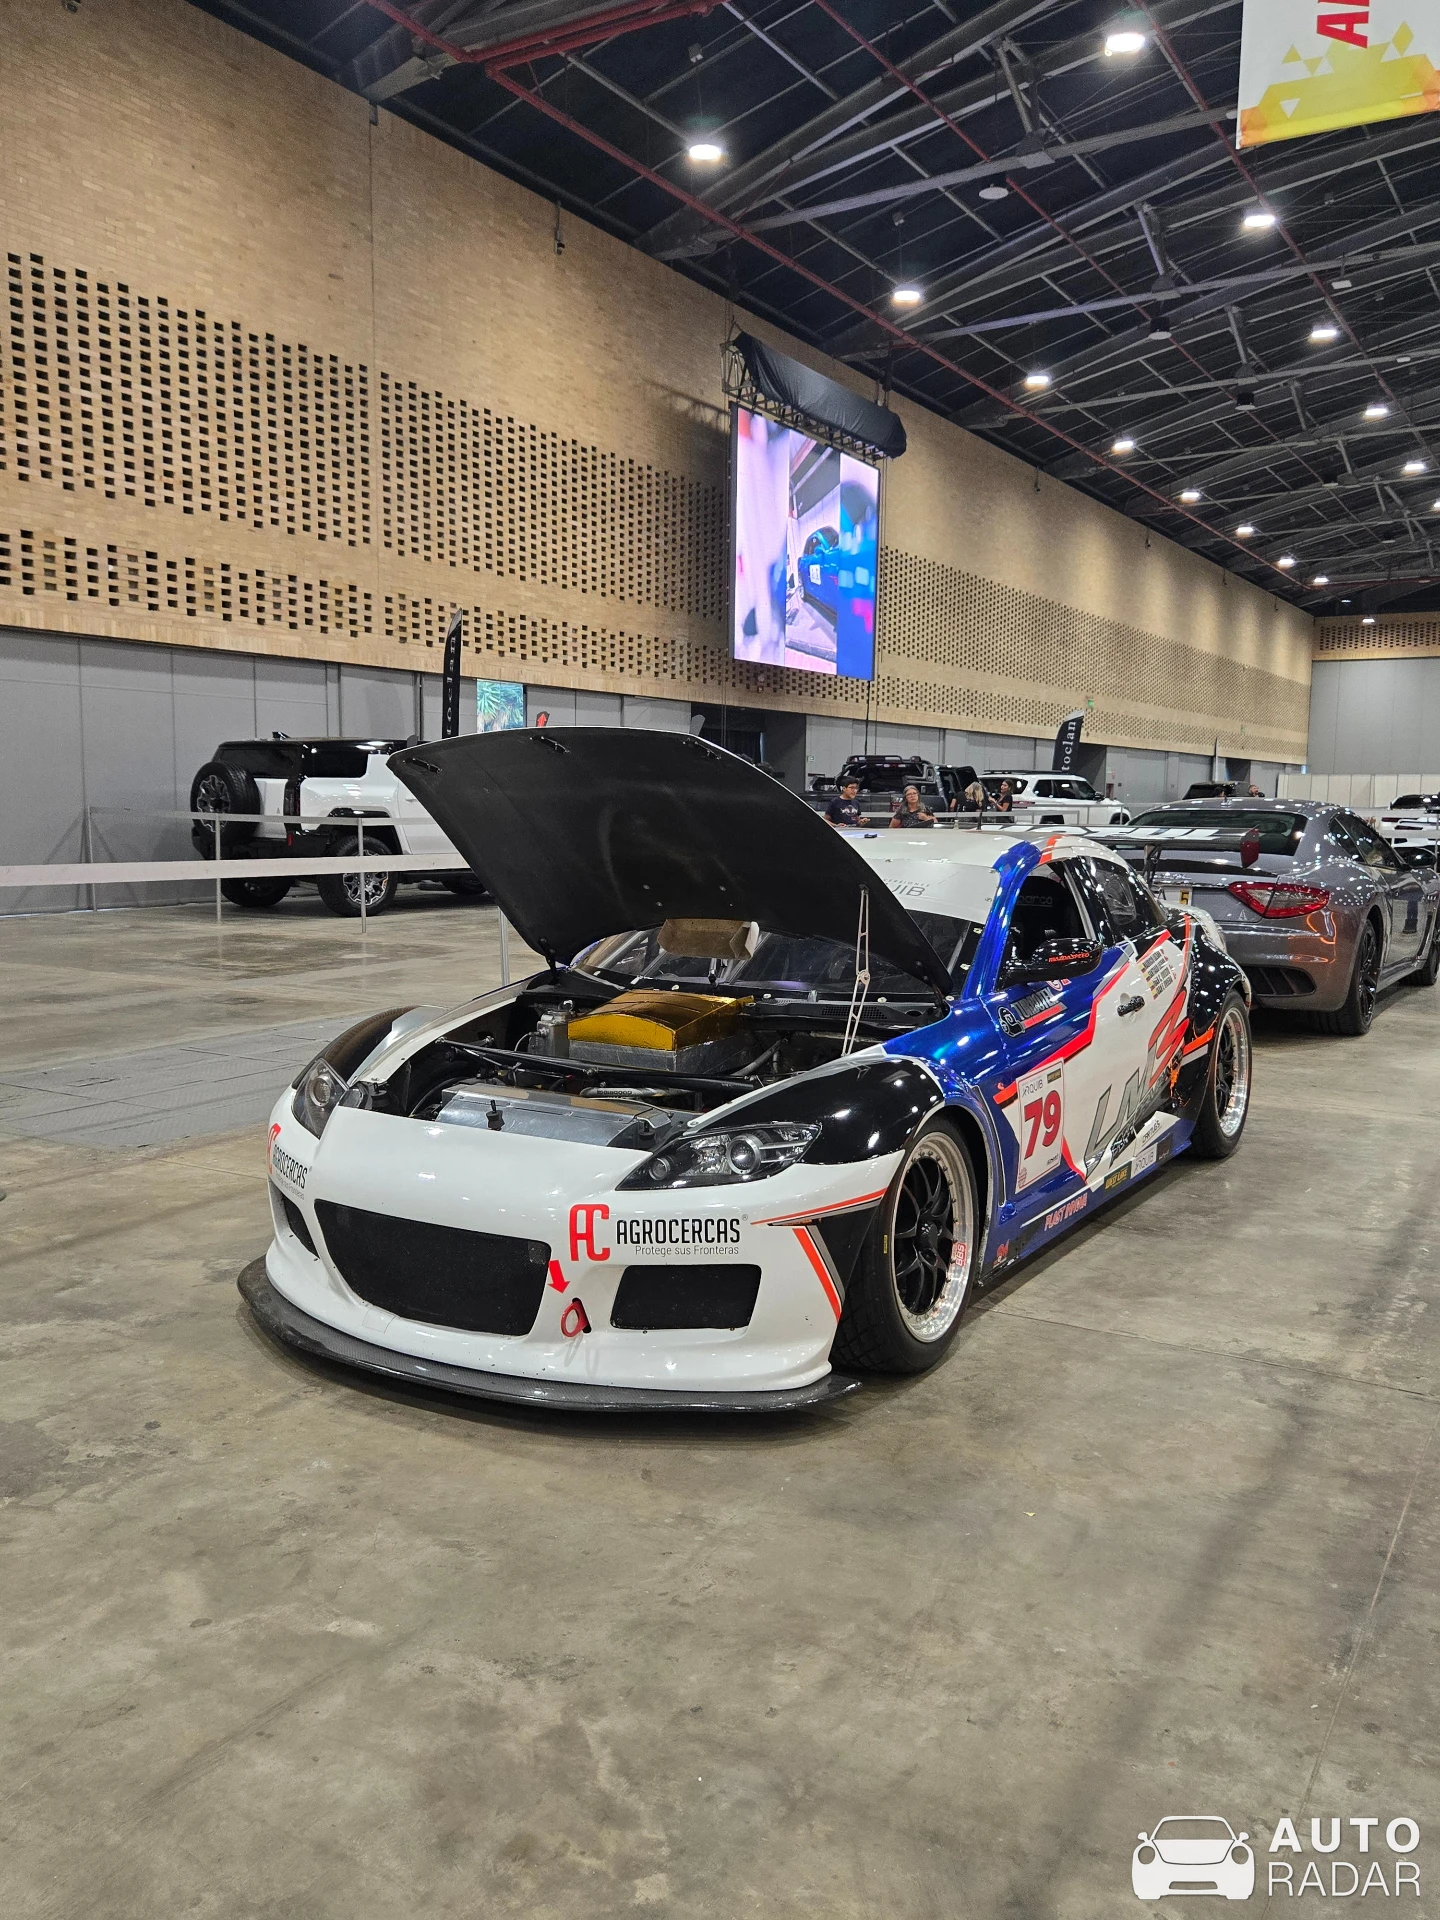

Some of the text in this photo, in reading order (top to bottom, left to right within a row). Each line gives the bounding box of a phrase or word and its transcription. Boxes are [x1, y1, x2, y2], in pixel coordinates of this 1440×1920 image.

[1061, 721, 1076, 771] toclan
[1018, 895, 1053, 905] parco
[1023, 1090, 1062, 1161] 79
[616, 1218, 741, 1245] AGROCERCAS
[635, 1245, 739, 1257] Protege sus Fronteras
